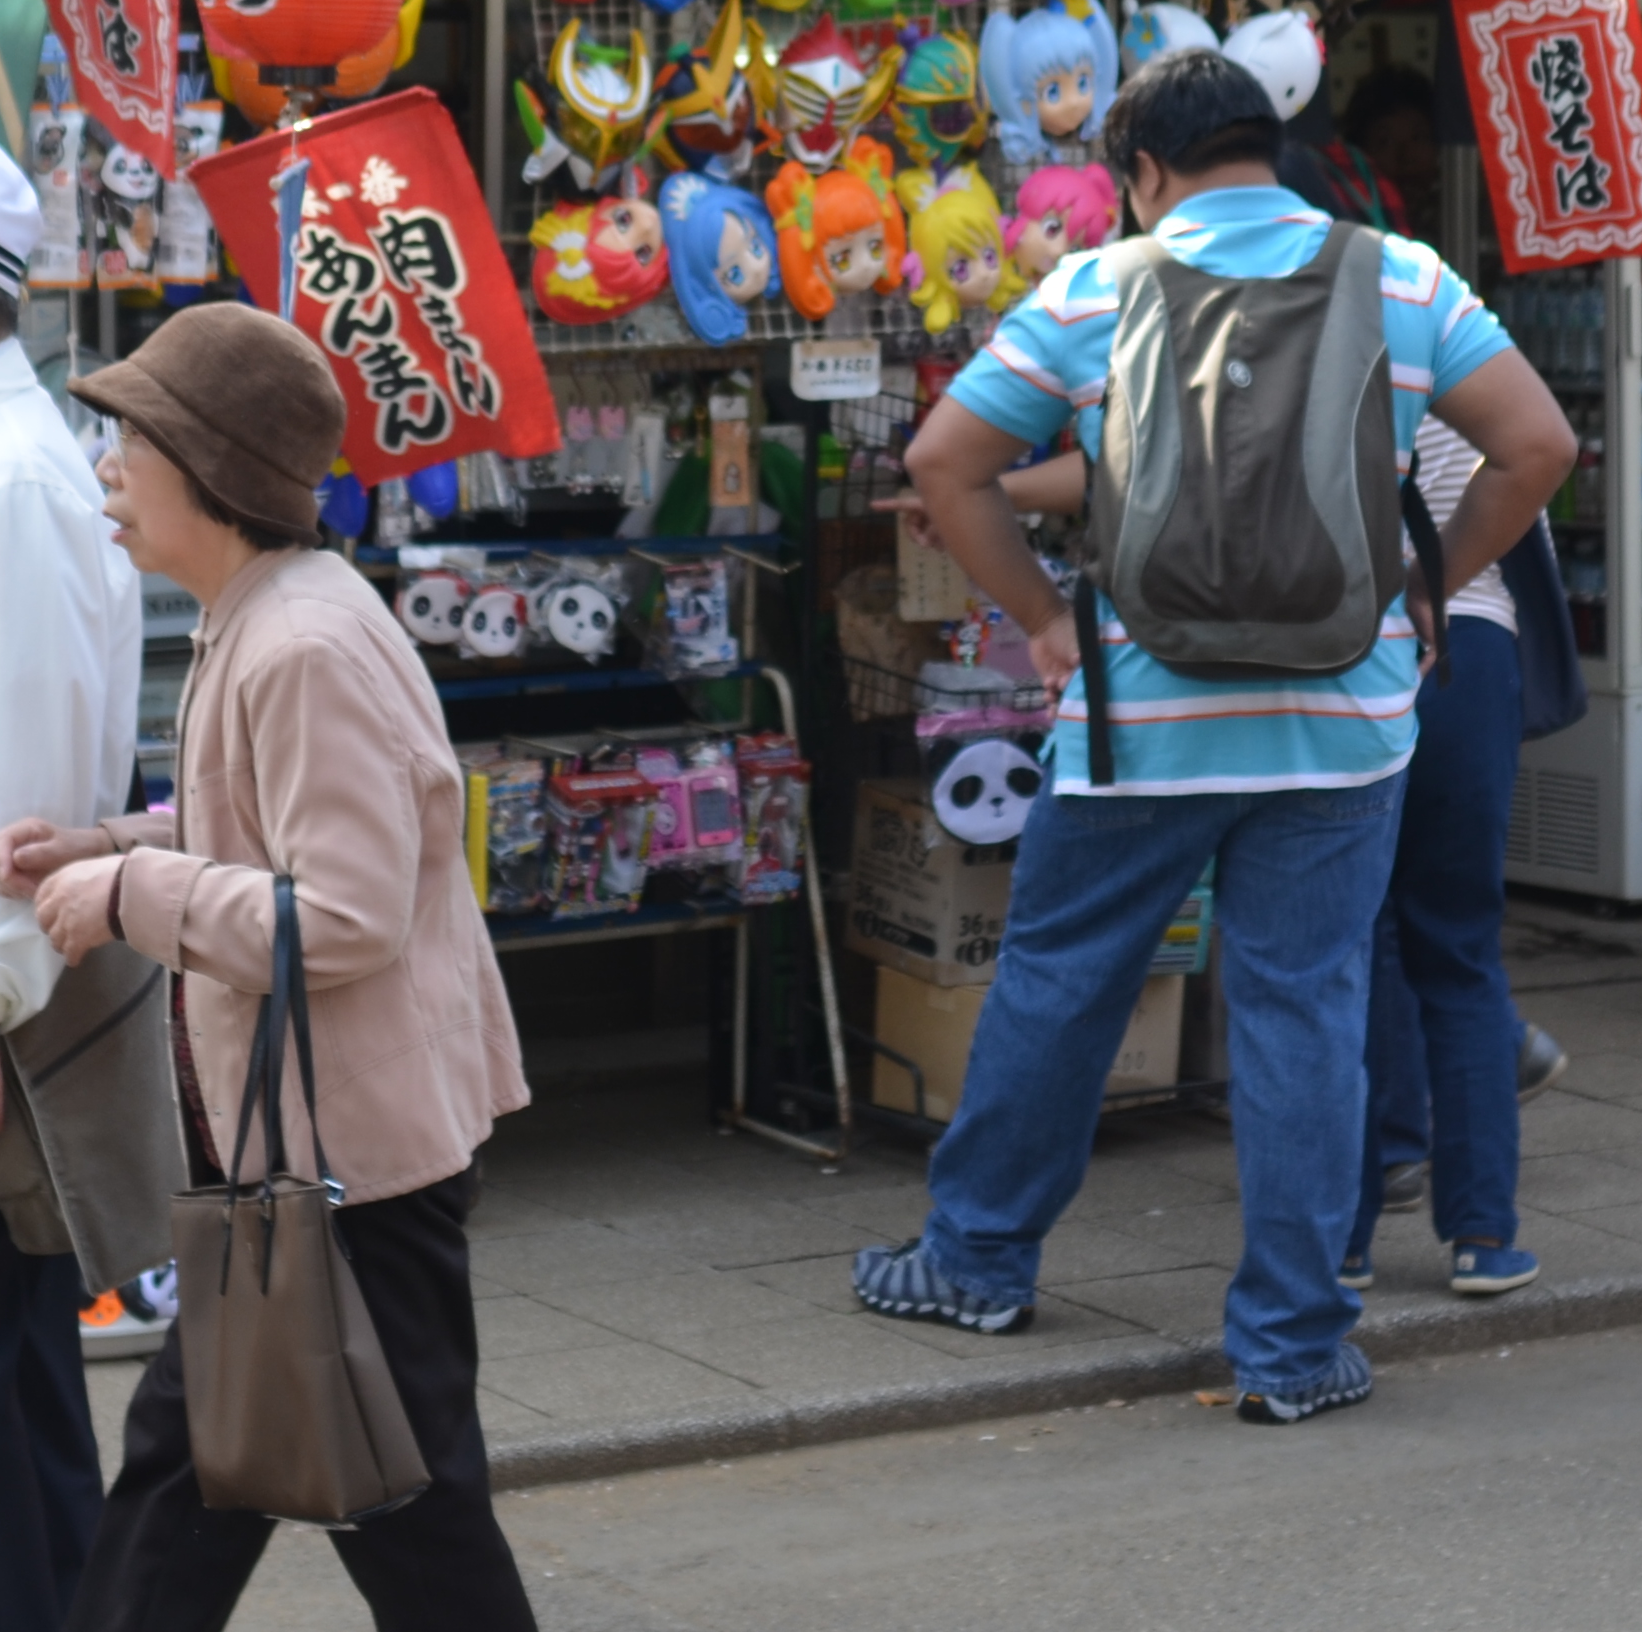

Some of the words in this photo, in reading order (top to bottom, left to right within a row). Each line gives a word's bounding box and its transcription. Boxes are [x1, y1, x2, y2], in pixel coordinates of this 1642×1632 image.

[1527, 33, 1612, 217] 焼そば
[296, 223, 455, 455] あんまん
[367, 206, 502, 421] 肉まん
